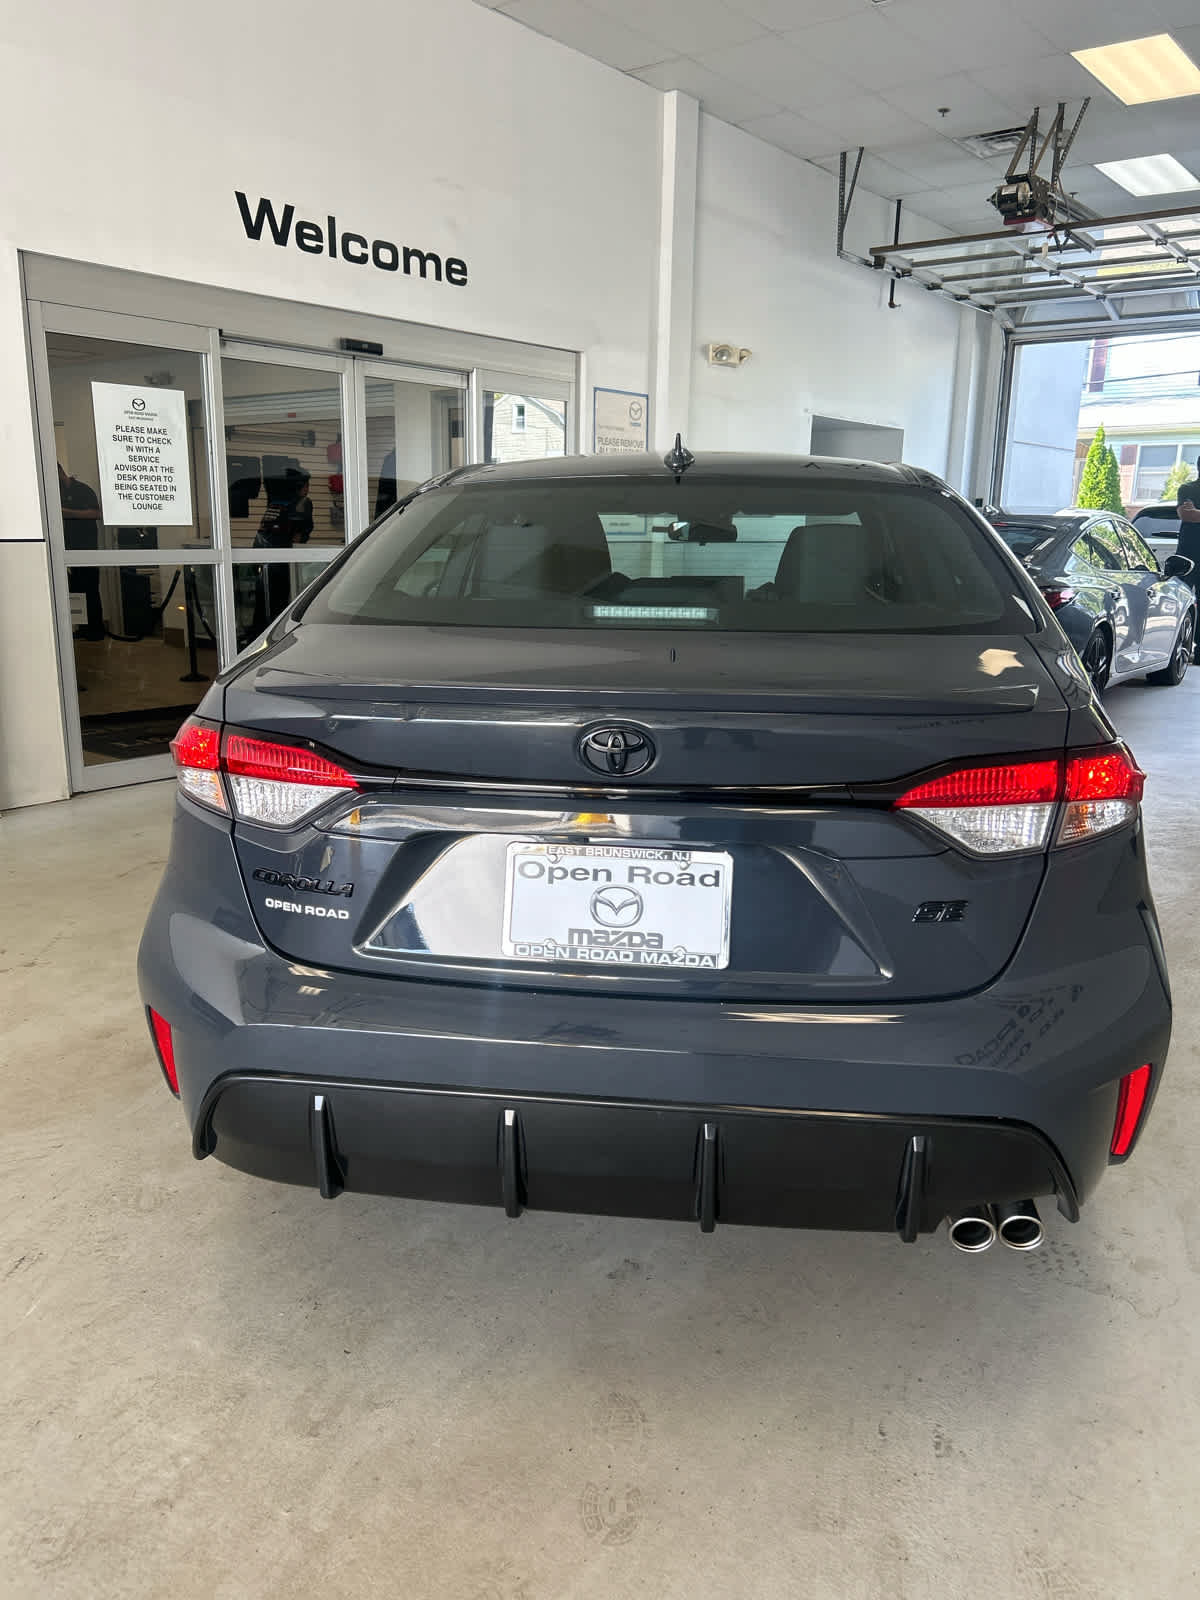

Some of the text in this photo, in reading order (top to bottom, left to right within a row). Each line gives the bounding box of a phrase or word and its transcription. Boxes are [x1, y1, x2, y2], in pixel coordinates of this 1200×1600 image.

[234, 190, 467, 286] Welcome
[115, 425, 168, 435] PLEASE MAKE
[112, 434, 133, 442] SURE
[147, 437, 172, 445] CHECK
[128, 455, 160, 463] SERVICE
[114, 464, 148, 472] ADVISOR
[163, 475, 173, 483] TO
[114, 483, 138, 491] BEING
[139, 484, 168, 492] SEATED
[134, 493, 175, 501] CUSTOMER
[548, 846, 692, 862] EAST BRUNSWICK, NJ
[518, 860, 720, 888] Open Road
[252, 867, 354, 898] COROLLA
[264, 897, 350, 920] OPEN ROAD
[515, 943, 716, 968] OPEN ROAD MAZDA
